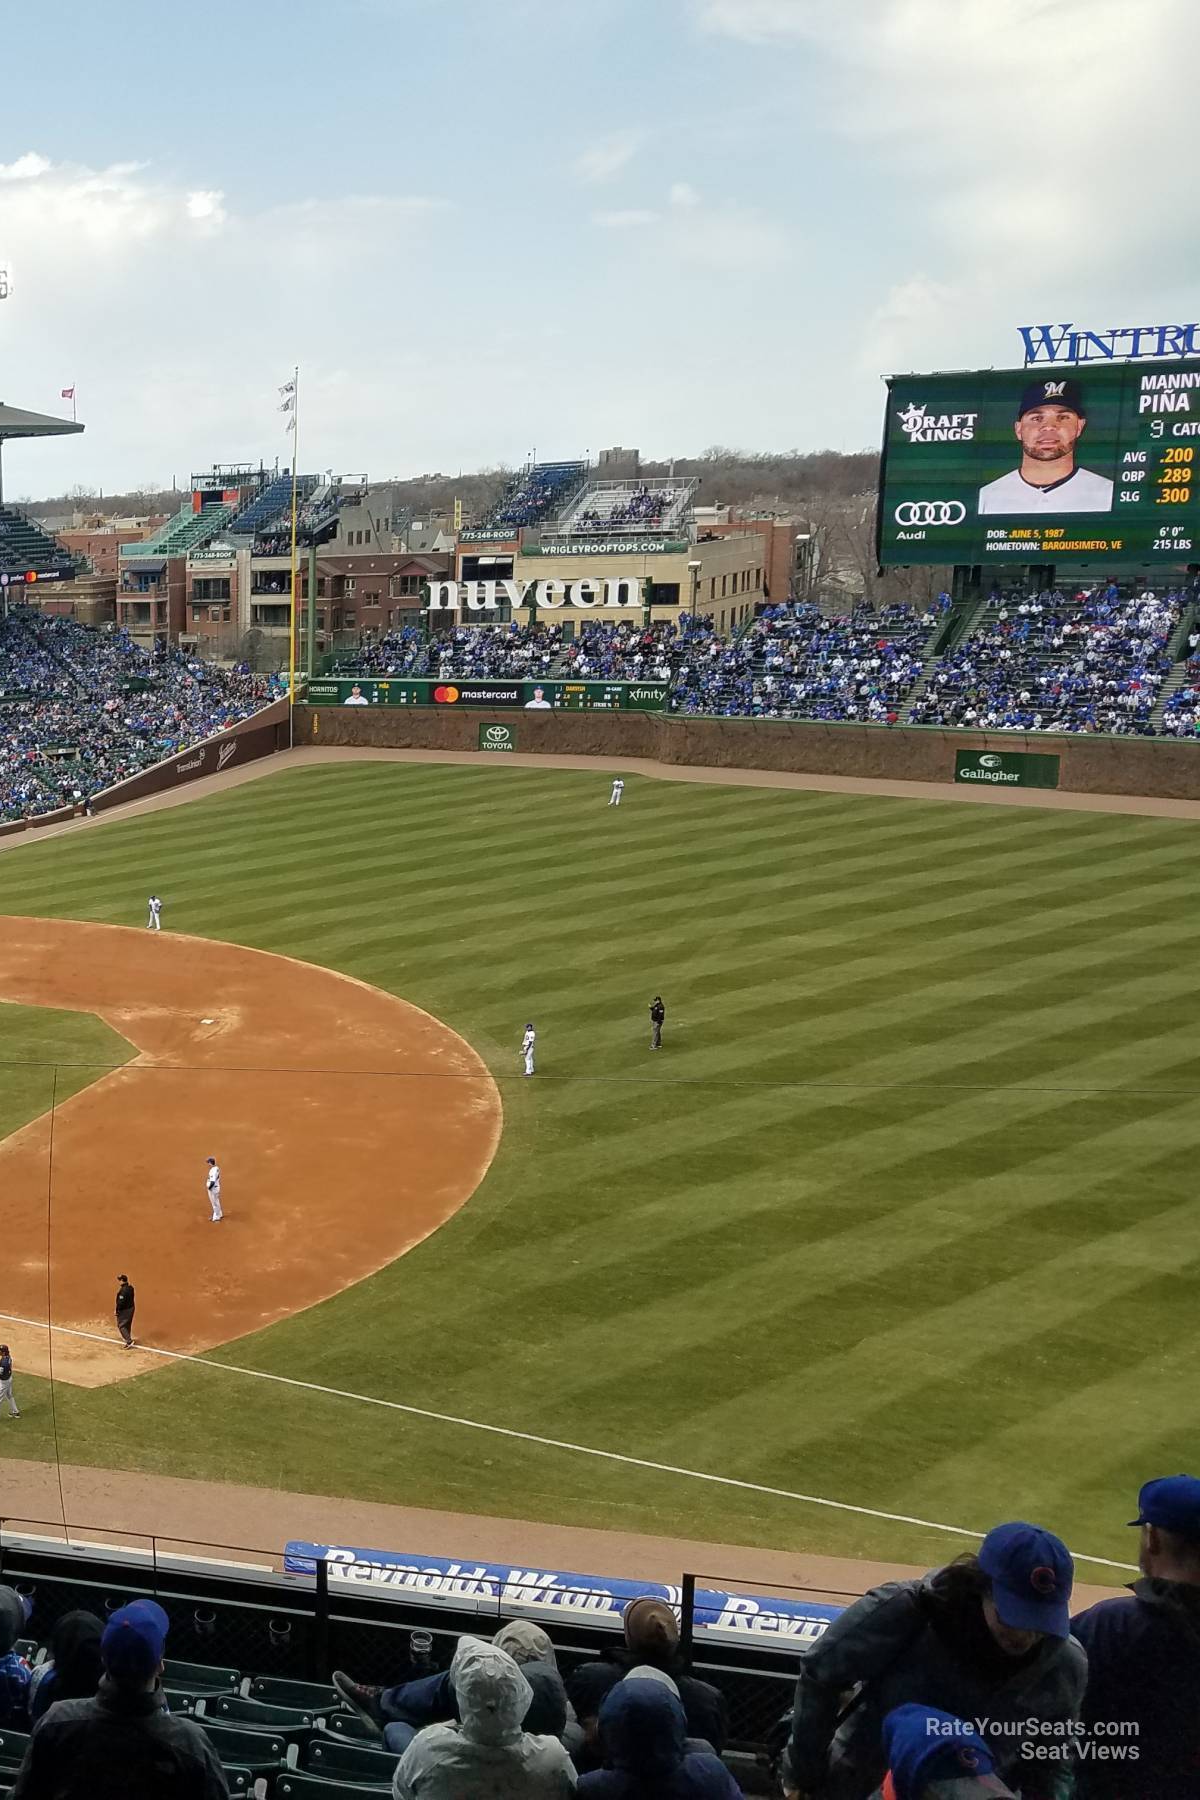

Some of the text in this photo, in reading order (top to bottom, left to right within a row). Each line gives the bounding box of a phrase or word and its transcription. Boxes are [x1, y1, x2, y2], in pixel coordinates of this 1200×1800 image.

[1139, 388, 1191, 413] PIÑA
[901, 413, 978, 433] DRAFT
[910, 427, 974, 442] KINGS
[1123, 447, 1194, 463] AVG .200
[1122, 467, 1192, 483] OBP .289
[1119, 487, 1190, 503] SLG .300
[461, 530, 515, 539] 773-248-ROOF
[896, 530, 926, 540] Audi
[987, 529, 1007, 538] DOB:
[1009, 529, 1032, 538] JUNE
[1044, 529, 1065, 538] 1987
[541, 543, 665, 554] WRIGLEYROOFTOPS.COM
[986, 541, 1040, 550] HOMETOWN:
[1111, 541, 1122, 549] VE
[1153, 539, 1192, 550] 215 LBS
[426, 577, 642, 610] nuveen
[461, 690, 517, 699] mastercard
[629, 688, 666, 701] xfinity
[482, 742, 513, 750] TOYOTA
[960, 768, 1020, 782] Gallagher
